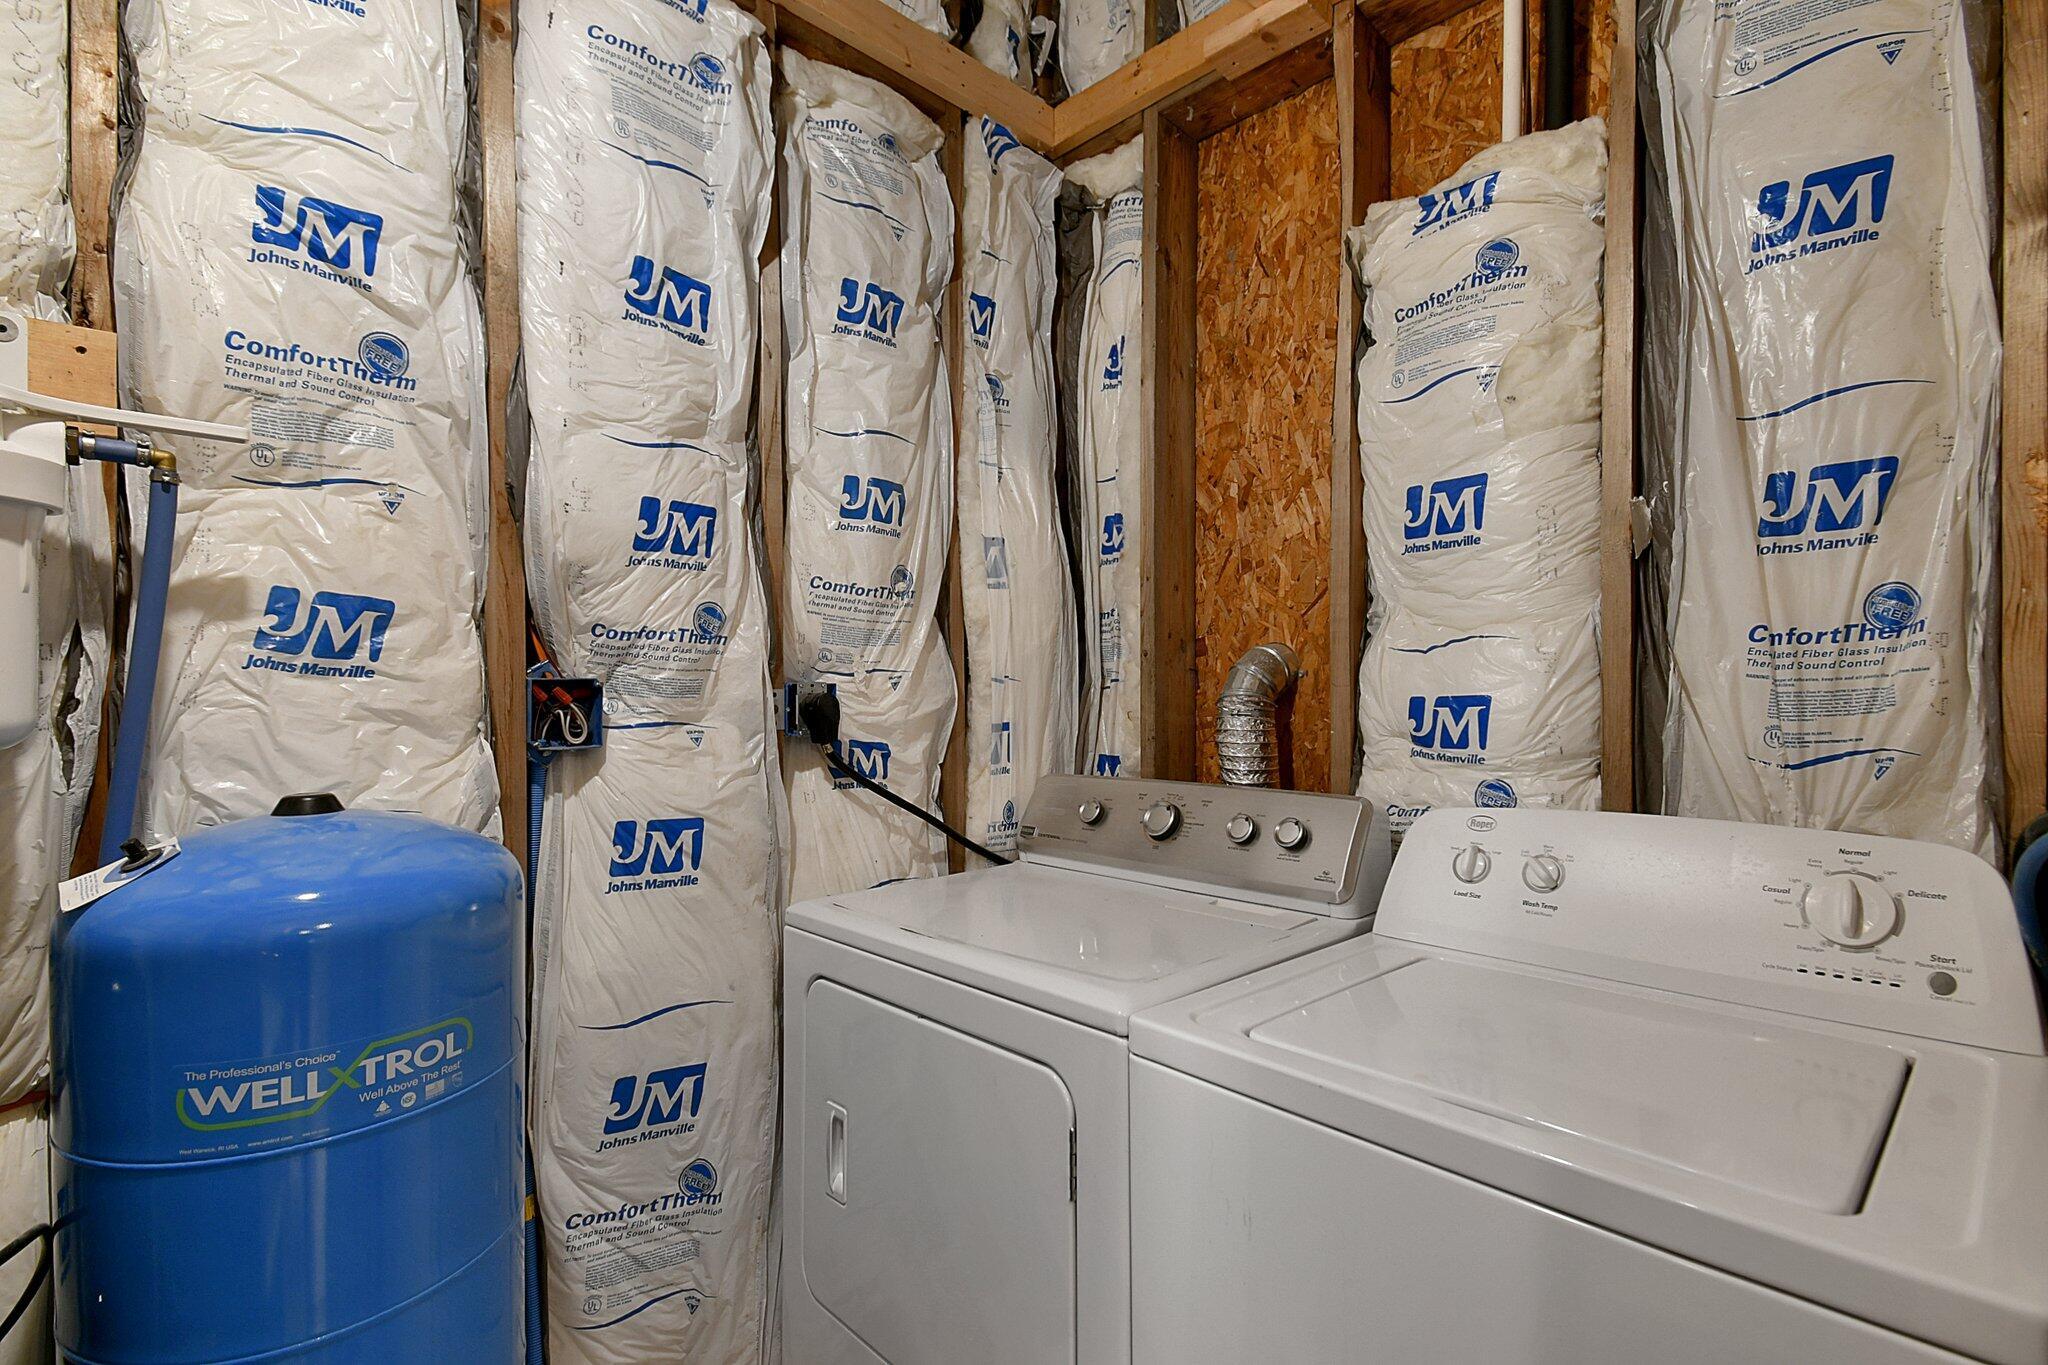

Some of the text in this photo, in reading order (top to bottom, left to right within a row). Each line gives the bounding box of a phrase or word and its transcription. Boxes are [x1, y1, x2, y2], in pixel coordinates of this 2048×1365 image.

[587, 24, 733, 95] ComfortTherm
[587, 41, 650, 73] Encapsulated
[650, 67, 672, 86] Fiber
[672, 82, 694, 99] Glass
[587, 51, 704, 112] Thermal and Sound Control
[1411, 171, 1502, 237] JM
[1752, 154, 1895, 253] JM
[252, 184, 384, 277] JM
[1745, 228, 1880, 275] Johns Manville
[247, 248, 373, 293] Johns Manville
[624, 255, 712, 334] JM
[837, 277, 905, 338] JM
[1455, 292, 1479, 304] Glass
[621, 308, 659, 329] Johns
[831, 323, 862, 337] Johns
[224, 330, 417, 391] ComfortTherm
[224, 366, 375, 406] Thermal and Sound Control
[225, 353, 416, 404] Encapsulated Fiber Glass Insulation
[839, 475, 906, 527] JM
[1404, 472, 1489, 540] JM
[1758, 456, 1900, 538] JM
[632, 495, 717, 559] JM
[835, 521, 901, 538] Johns Manville
[1401, 534, 1481, 555] Johns Manville
[625, 555, 708, 572] Johns Manville
[838, 603, 852, 612] and
[854, 606, 875, 615] Sound
[857, 598, 875, 607] Fiber
[253, 585, 396, 663] JM
[641, 651, 671, 663] Sound
[647, 642, 672, 654] Fiber
[672, 644, 693, 655] Glass
[1774, 656, 1885, 671] and Sound Control
[1801, 646, 1870, 659] Fiber Glass
[242, 654, 376, 678] Johns Manville
[1409, 694, 1493, 751] JM
[1410, 747, 1486, 765] Johns Manville
[1469, 818, 1494, 830] Roper
[609, 817, 705, 878] JM
[1838, 848, 1872, 857] Normal
[605, 875, 699, 894] Johns Manville
[1453, 890, 1482, 899] Load Size
[1761, 884, 1791, 895] Casual
[1907, 889, 1948, 901] Delicate
[1522, 900, 1559, 912] Wash Temp
[1761, 962, 1775, 971] Cycle
[1929, 954, 1958, 966] Start
[184, 1053, 336, 1082] The Professional's Choice
[359, 1060, 462, 1103] Well Above The Rest
[603, 1062, 708, 1136] JM
[596, 1122, 695, 1153] Johns Manville
[565, 1190, 723, 1231] ComfortTherm
[566, 1222, 629, 1244] Encapsulated
[655, 1211, 680, 1222] Glass
[682, 1207, 723, 1218] Insulation
[564, 1219, 691, 1253] Thermal and Sound Control
